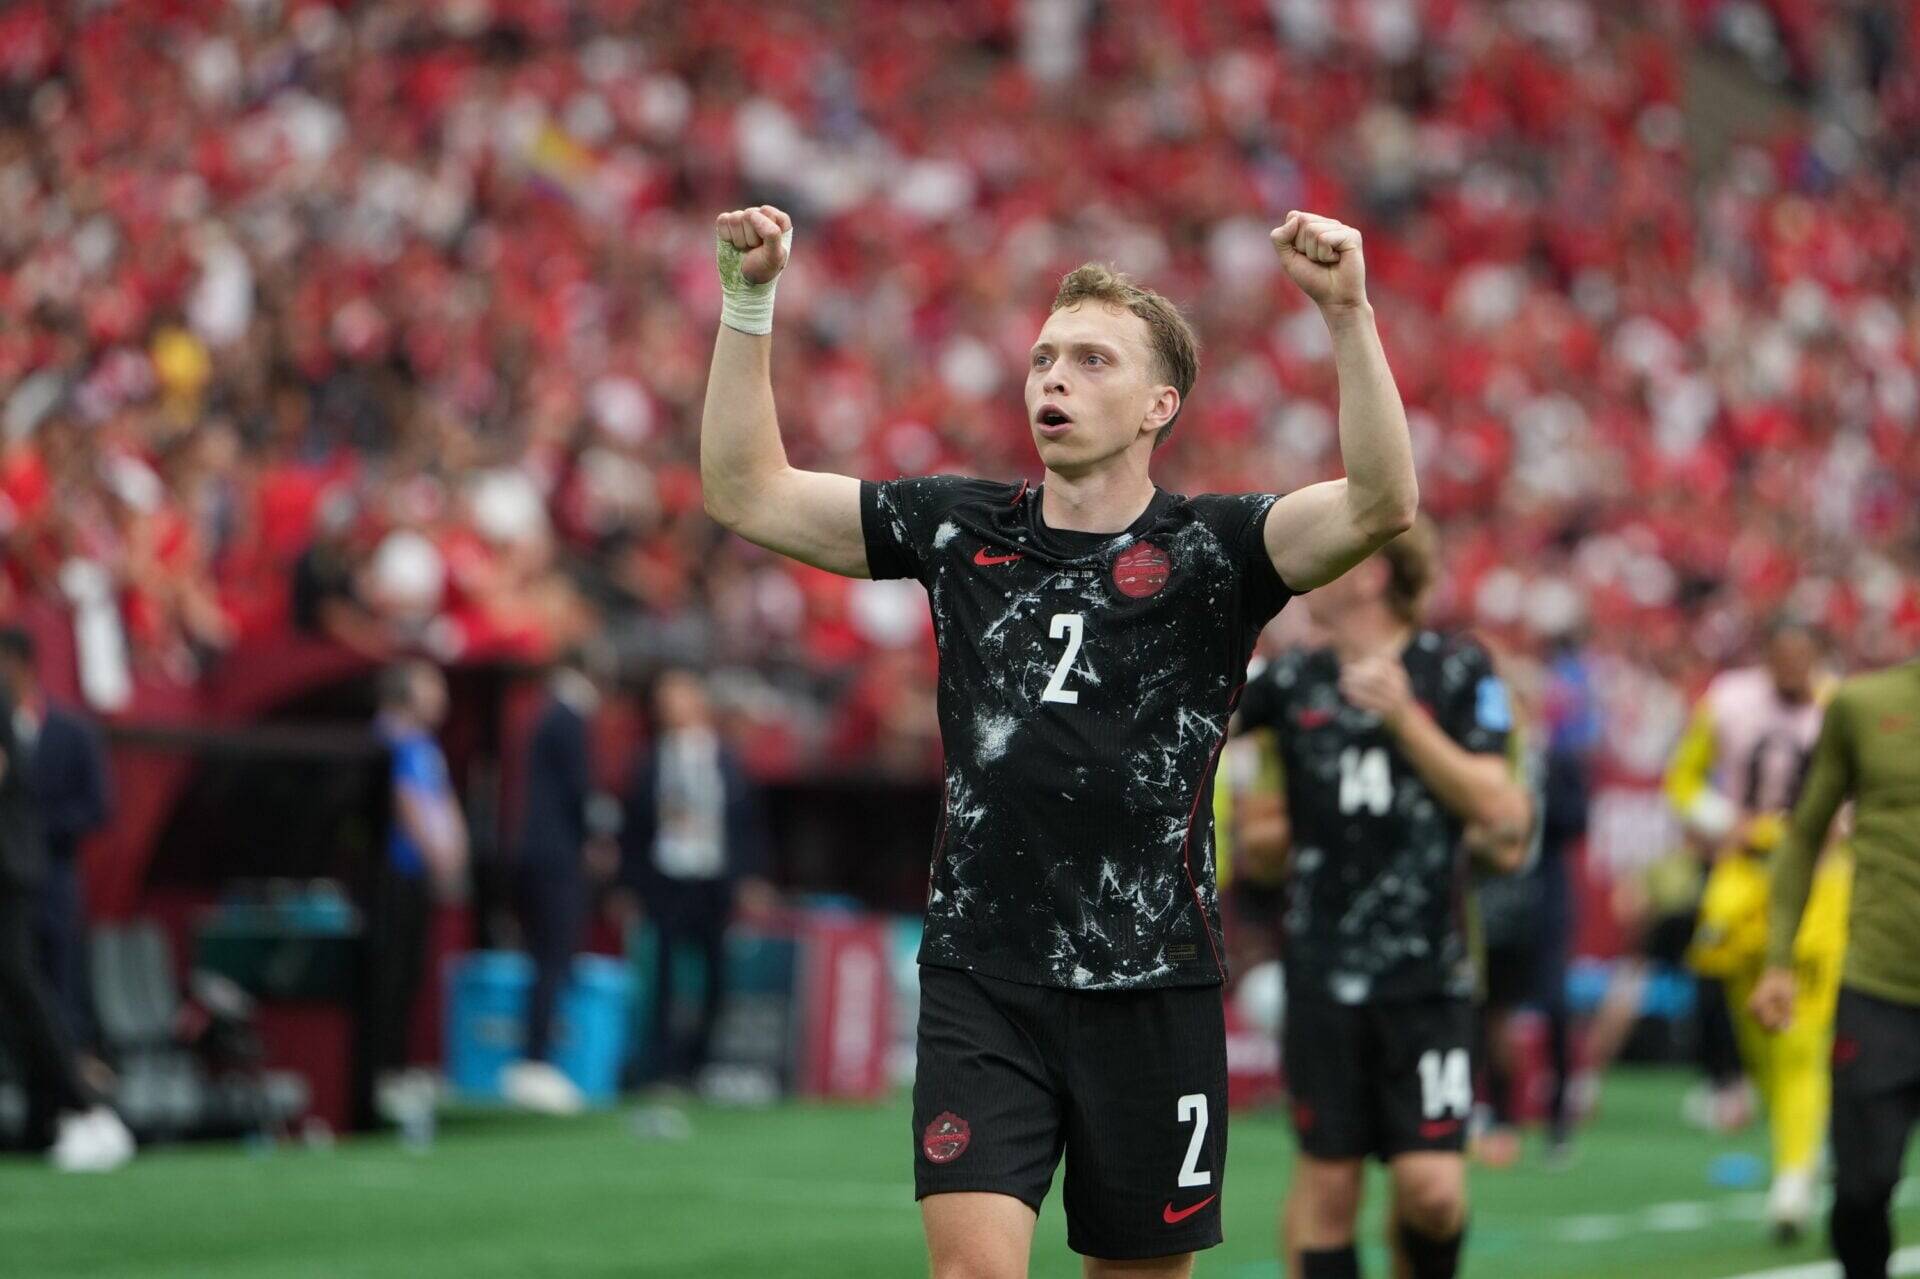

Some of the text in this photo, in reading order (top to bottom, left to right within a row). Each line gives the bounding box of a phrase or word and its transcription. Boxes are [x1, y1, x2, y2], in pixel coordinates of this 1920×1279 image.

[1042, 613, 1084, 704] 2
[1339, 749, 1392, 815] 14
[1418, 1049, 1472, 1118] 14
[1177, 1093, 1212, 1188] 2
